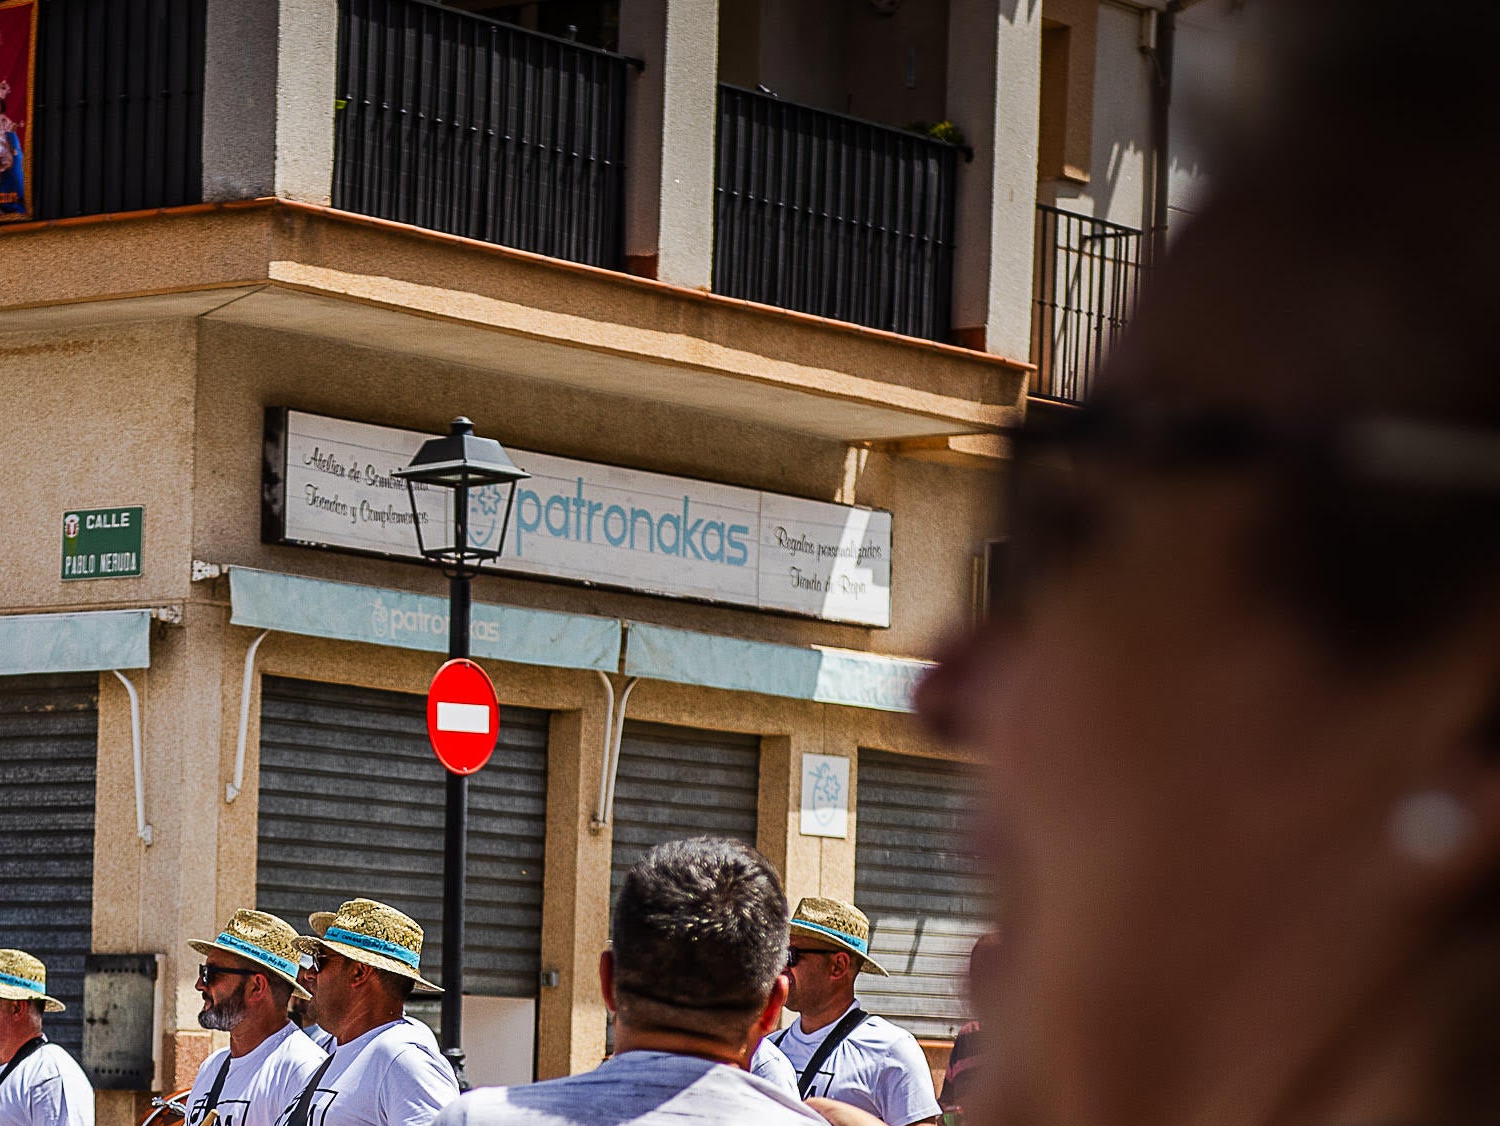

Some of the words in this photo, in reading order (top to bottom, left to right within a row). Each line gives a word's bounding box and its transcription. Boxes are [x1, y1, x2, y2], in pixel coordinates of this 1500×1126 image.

[86, 512, 130, 529] CALLE
[359, 499, 429, 528] Complemenos
[516, 476, 749, 567] patronakas
[773, 526, 815, 556] Regalos
[65, 554, 95, 575] PABLO
[100, 552, 137, 573] NERUDA
[788, 566, 822, 592] Tienda
